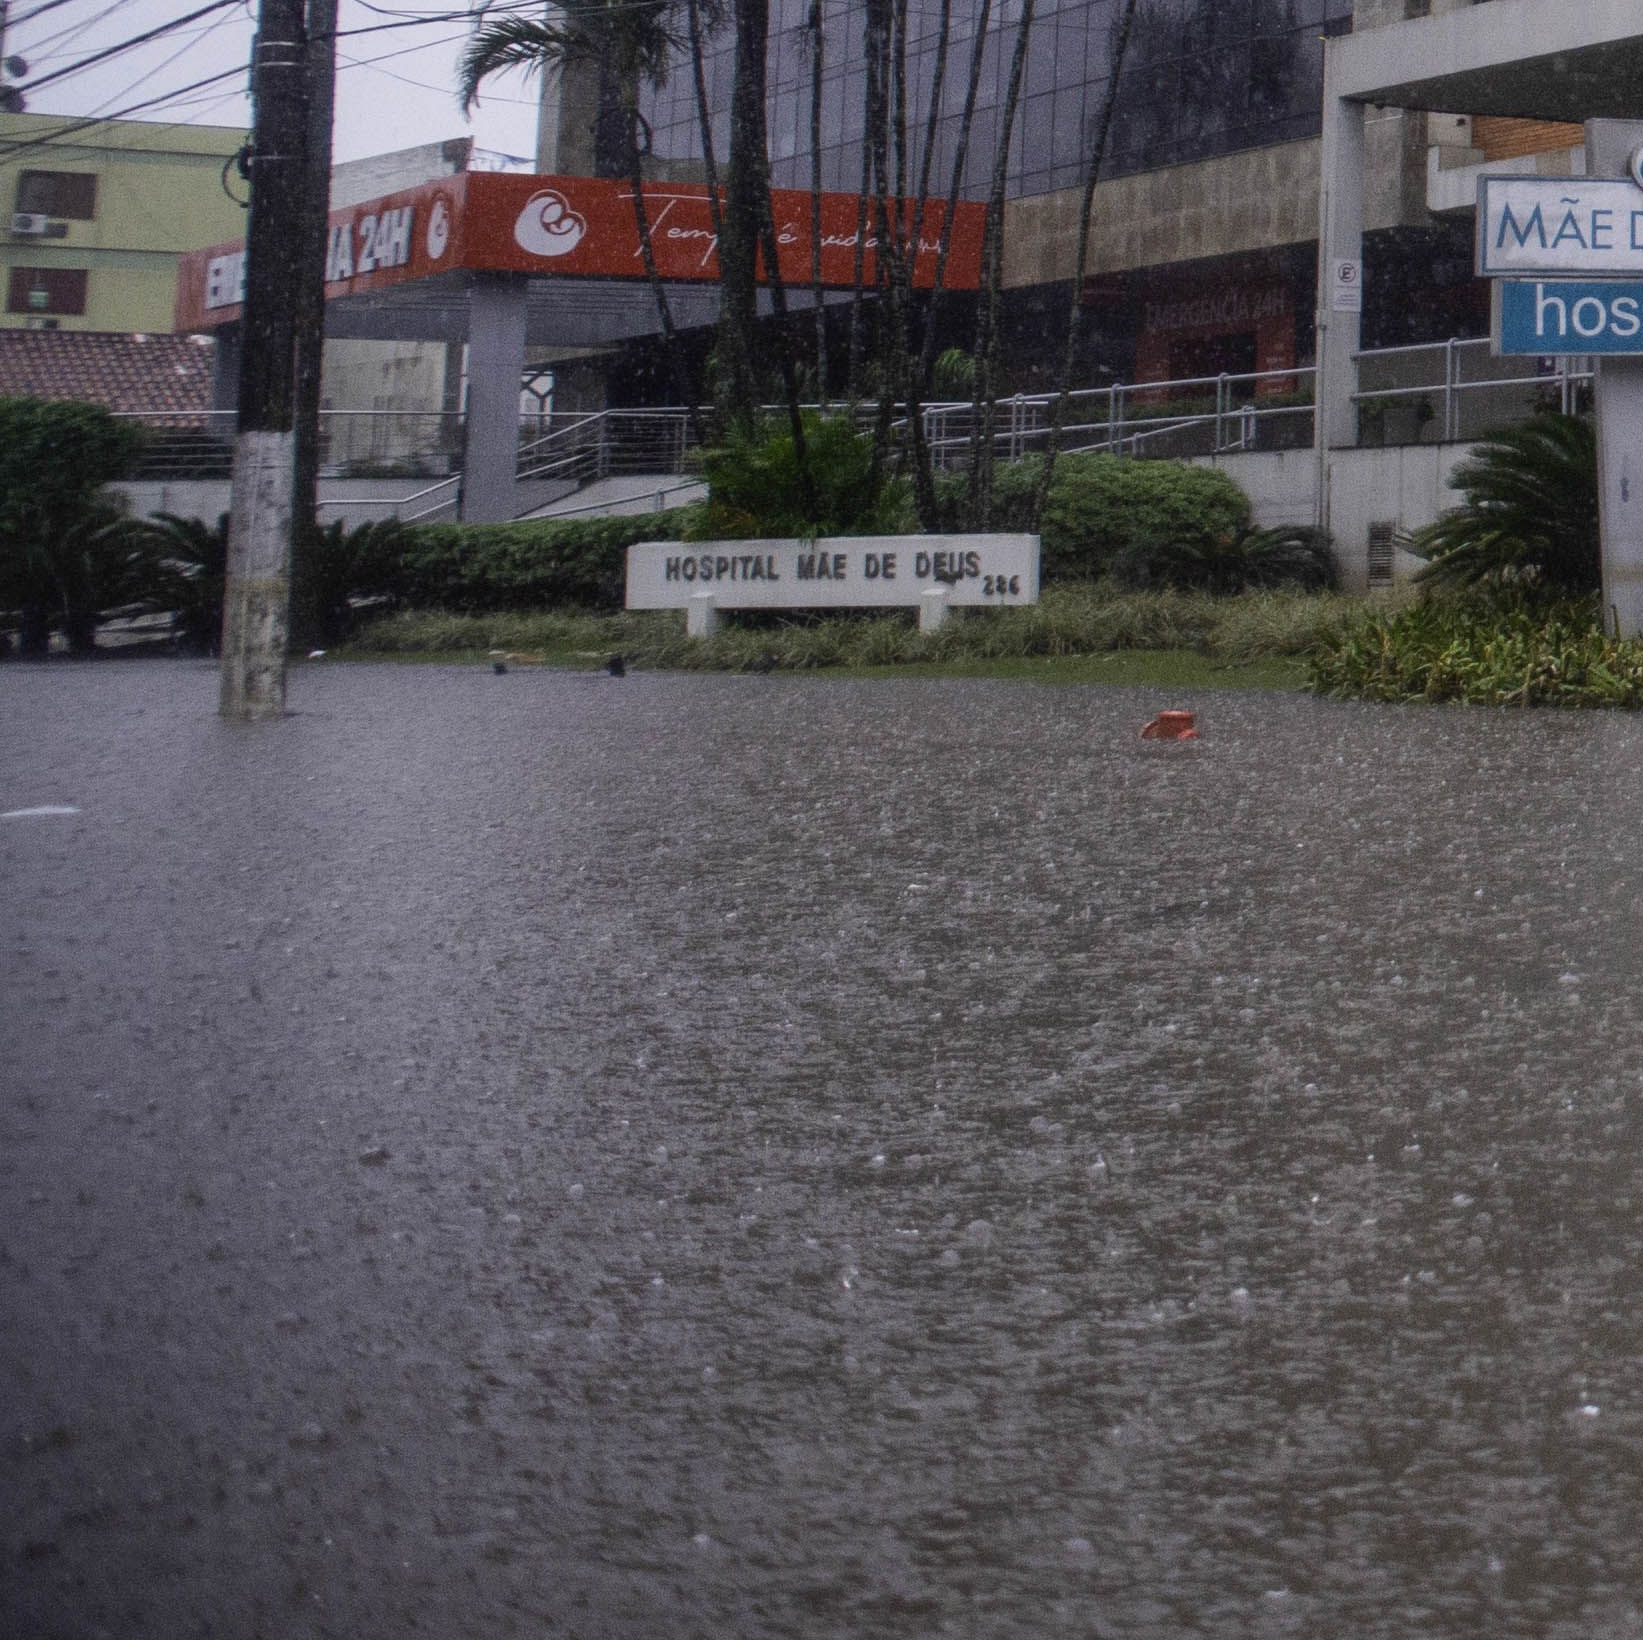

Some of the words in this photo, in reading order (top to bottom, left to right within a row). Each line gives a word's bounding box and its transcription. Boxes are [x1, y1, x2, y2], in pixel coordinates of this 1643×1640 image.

[358, 206, 415, 274] 24H
[1495, 196, 1614, 251] MÃE
[665, 554, 780, 583] HOSPITAL
[864, 552, 897, 580] DE
[914, 550, 981, 582] DEUS
